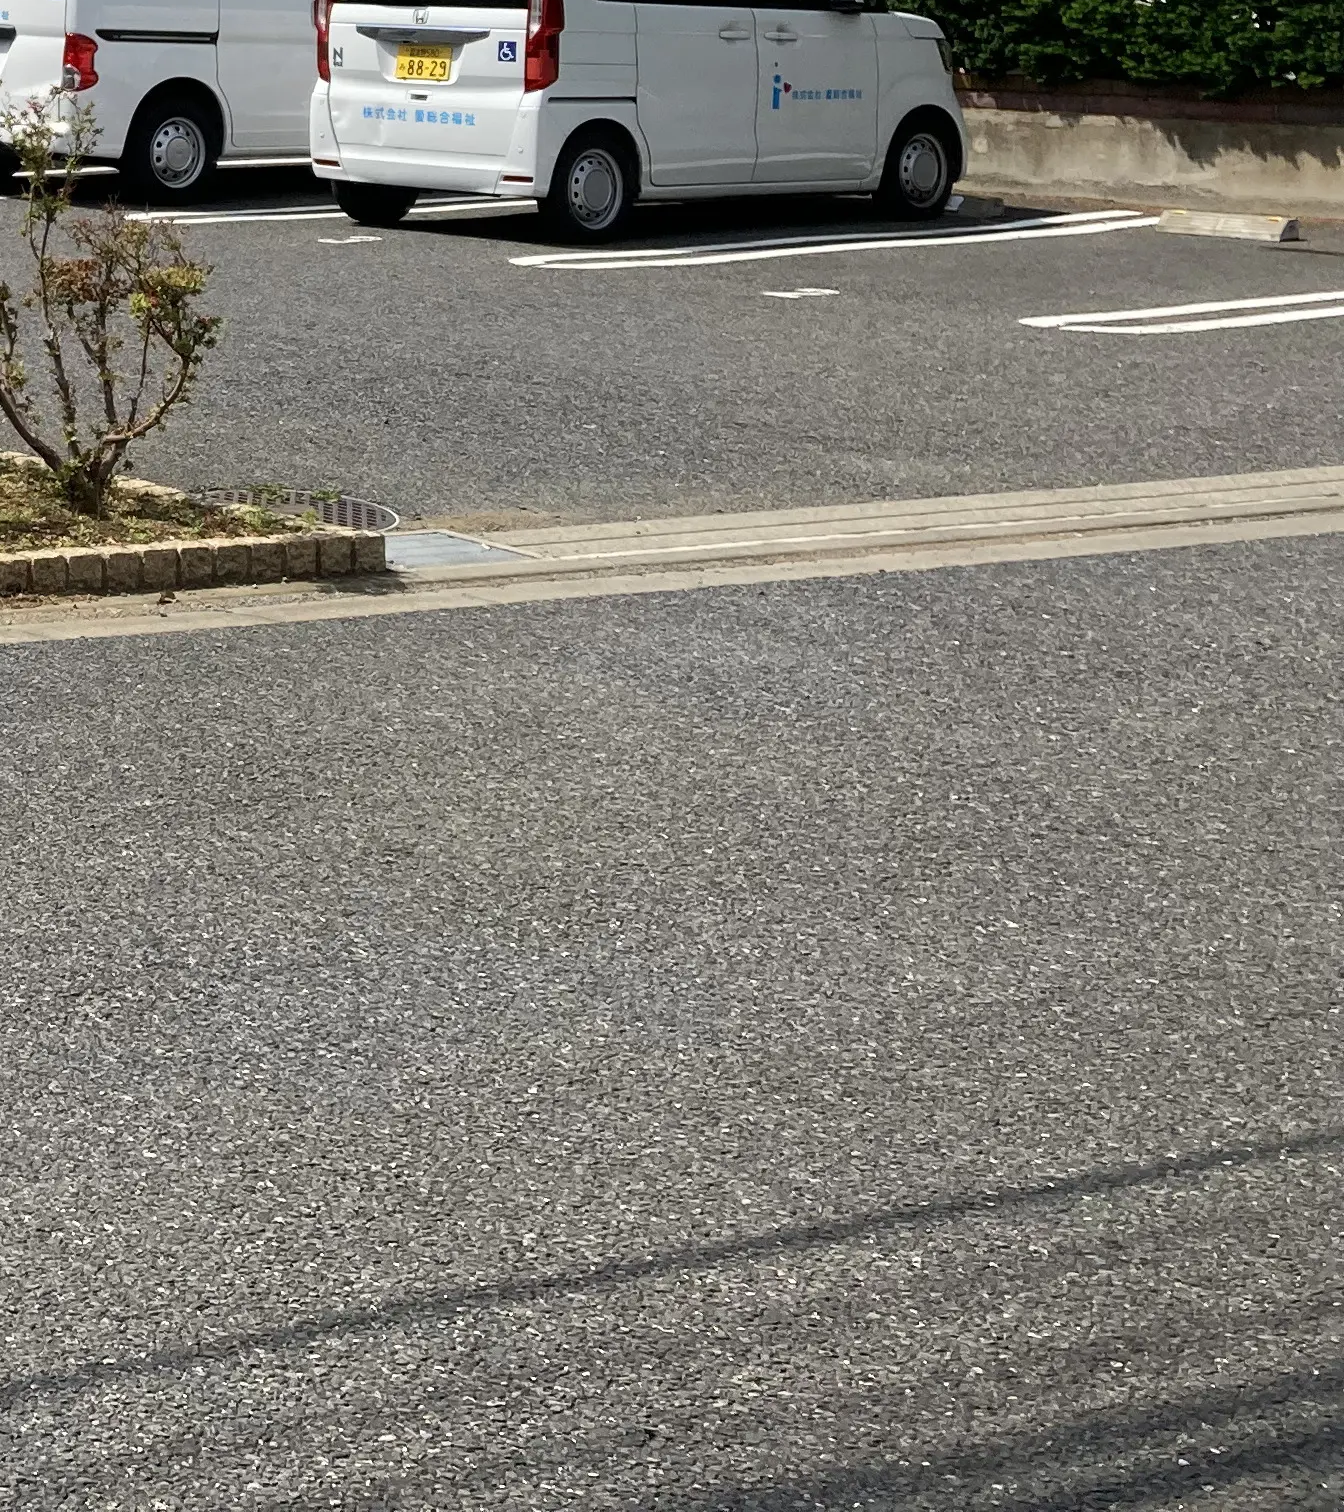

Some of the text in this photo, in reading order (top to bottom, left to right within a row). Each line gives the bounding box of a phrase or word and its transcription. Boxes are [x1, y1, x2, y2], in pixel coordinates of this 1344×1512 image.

[407, 59, 447, 77] 88-29
[362, 106, 476, 126] 株式会社 愛総合福祉
